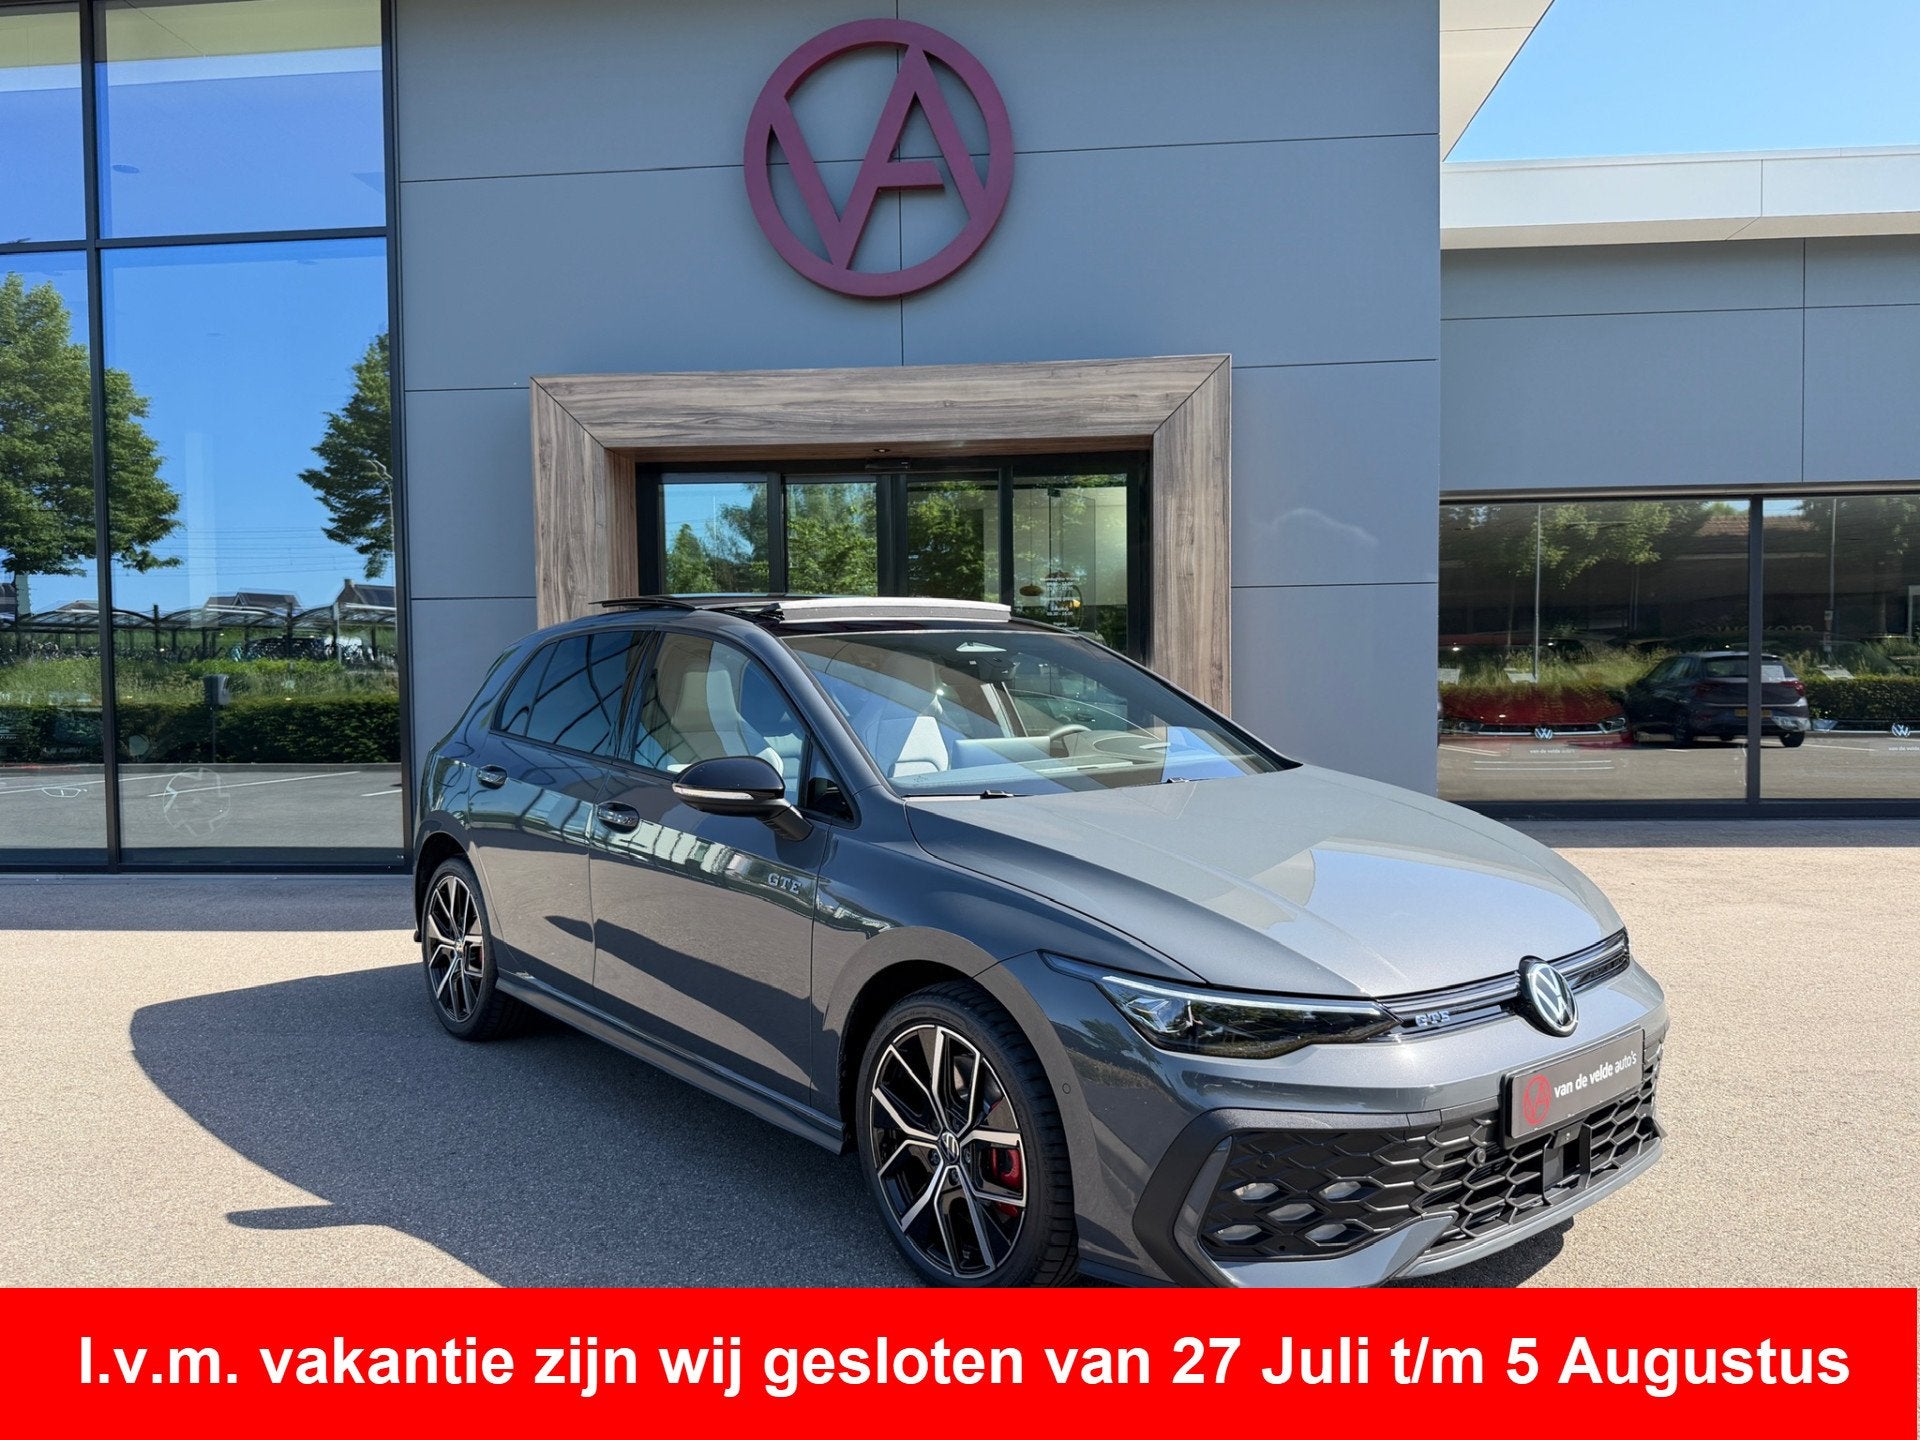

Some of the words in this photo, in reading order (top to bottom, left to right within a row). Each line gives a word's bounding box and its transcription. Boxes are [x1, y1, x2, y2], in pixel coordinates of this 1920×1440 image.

[757, 35, 995, 278] VA
[768, 873, 801, 894] GTE
[1554, 1081, 1573, 1098] van
[1575, 1074, 1588, 1090] de
[1589, 1062, 1614, 1085] velde
[1614, 1050, 1637, 1073] auto's
